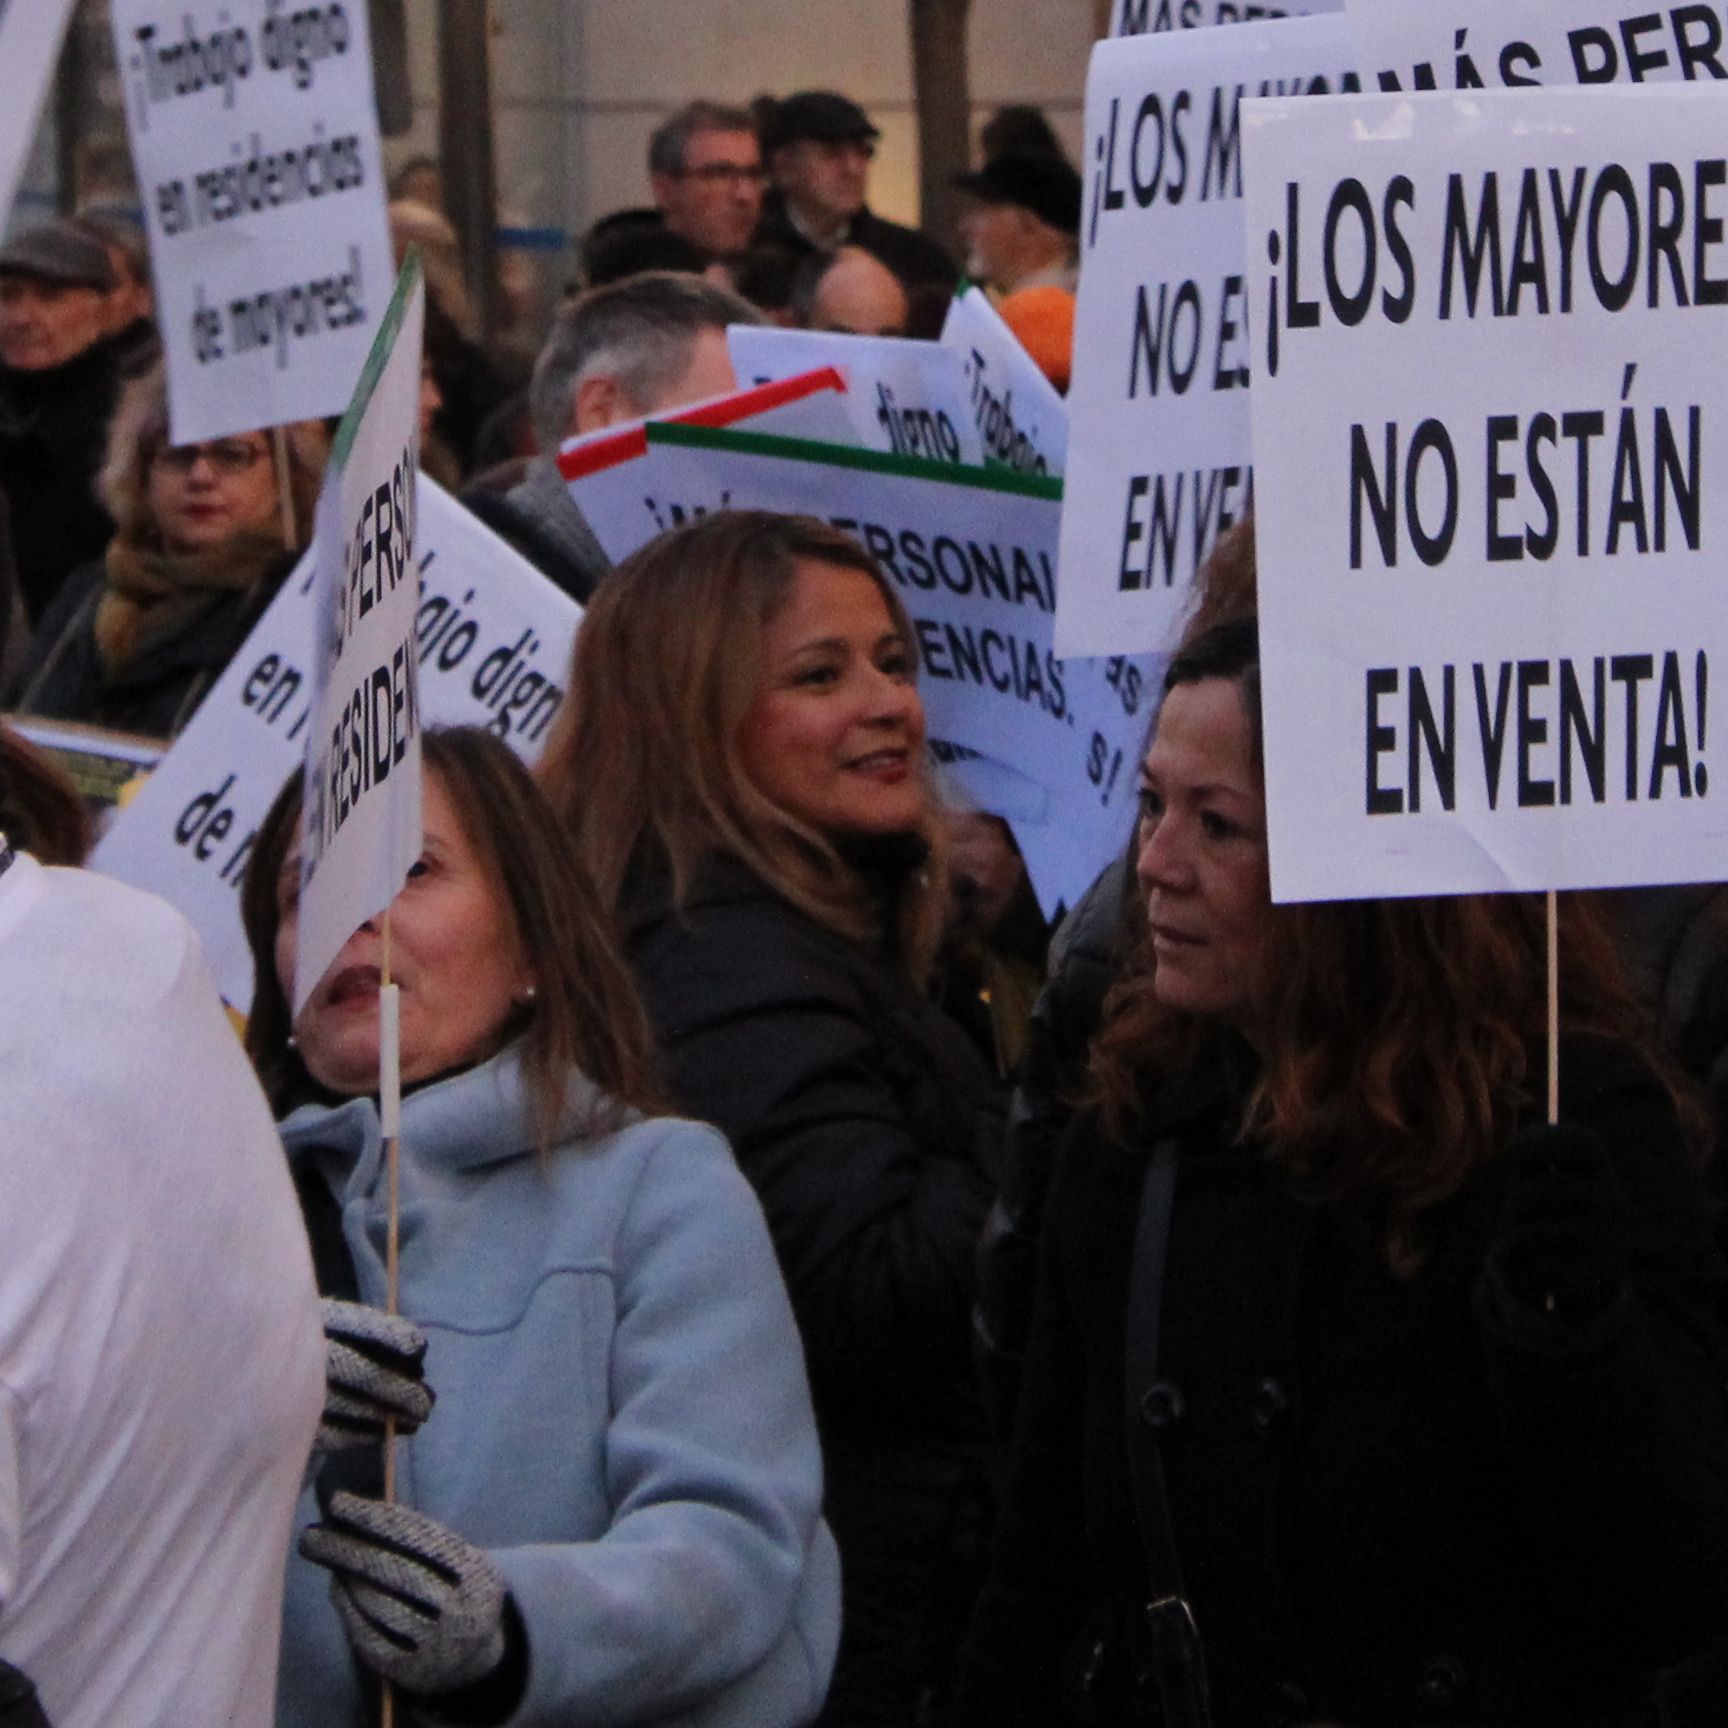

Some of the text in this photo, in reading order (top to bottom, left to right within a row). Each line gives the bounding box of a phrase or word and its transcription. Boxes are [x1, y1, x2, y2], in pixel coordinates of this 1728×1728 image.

[130, 10, 252, 132] ¡Trabajo
[156, 120, 366, 237] en residencias
[1090, 89, 1191, 249] ¡LOS
[191, 244, 365, 370] de mayores!
[1265, 174, 1417, 378] ¡LOS
[1128, 279, 1201, 399] NO
[1348, 361, 1702, 570] NO ESTÁN
[1118, 472, 1184, 592] EN
[241, 652, 302, 724] en
[1364, 647, 1709, 815] EN VENTA!
[173, 773, 235, 862] de
